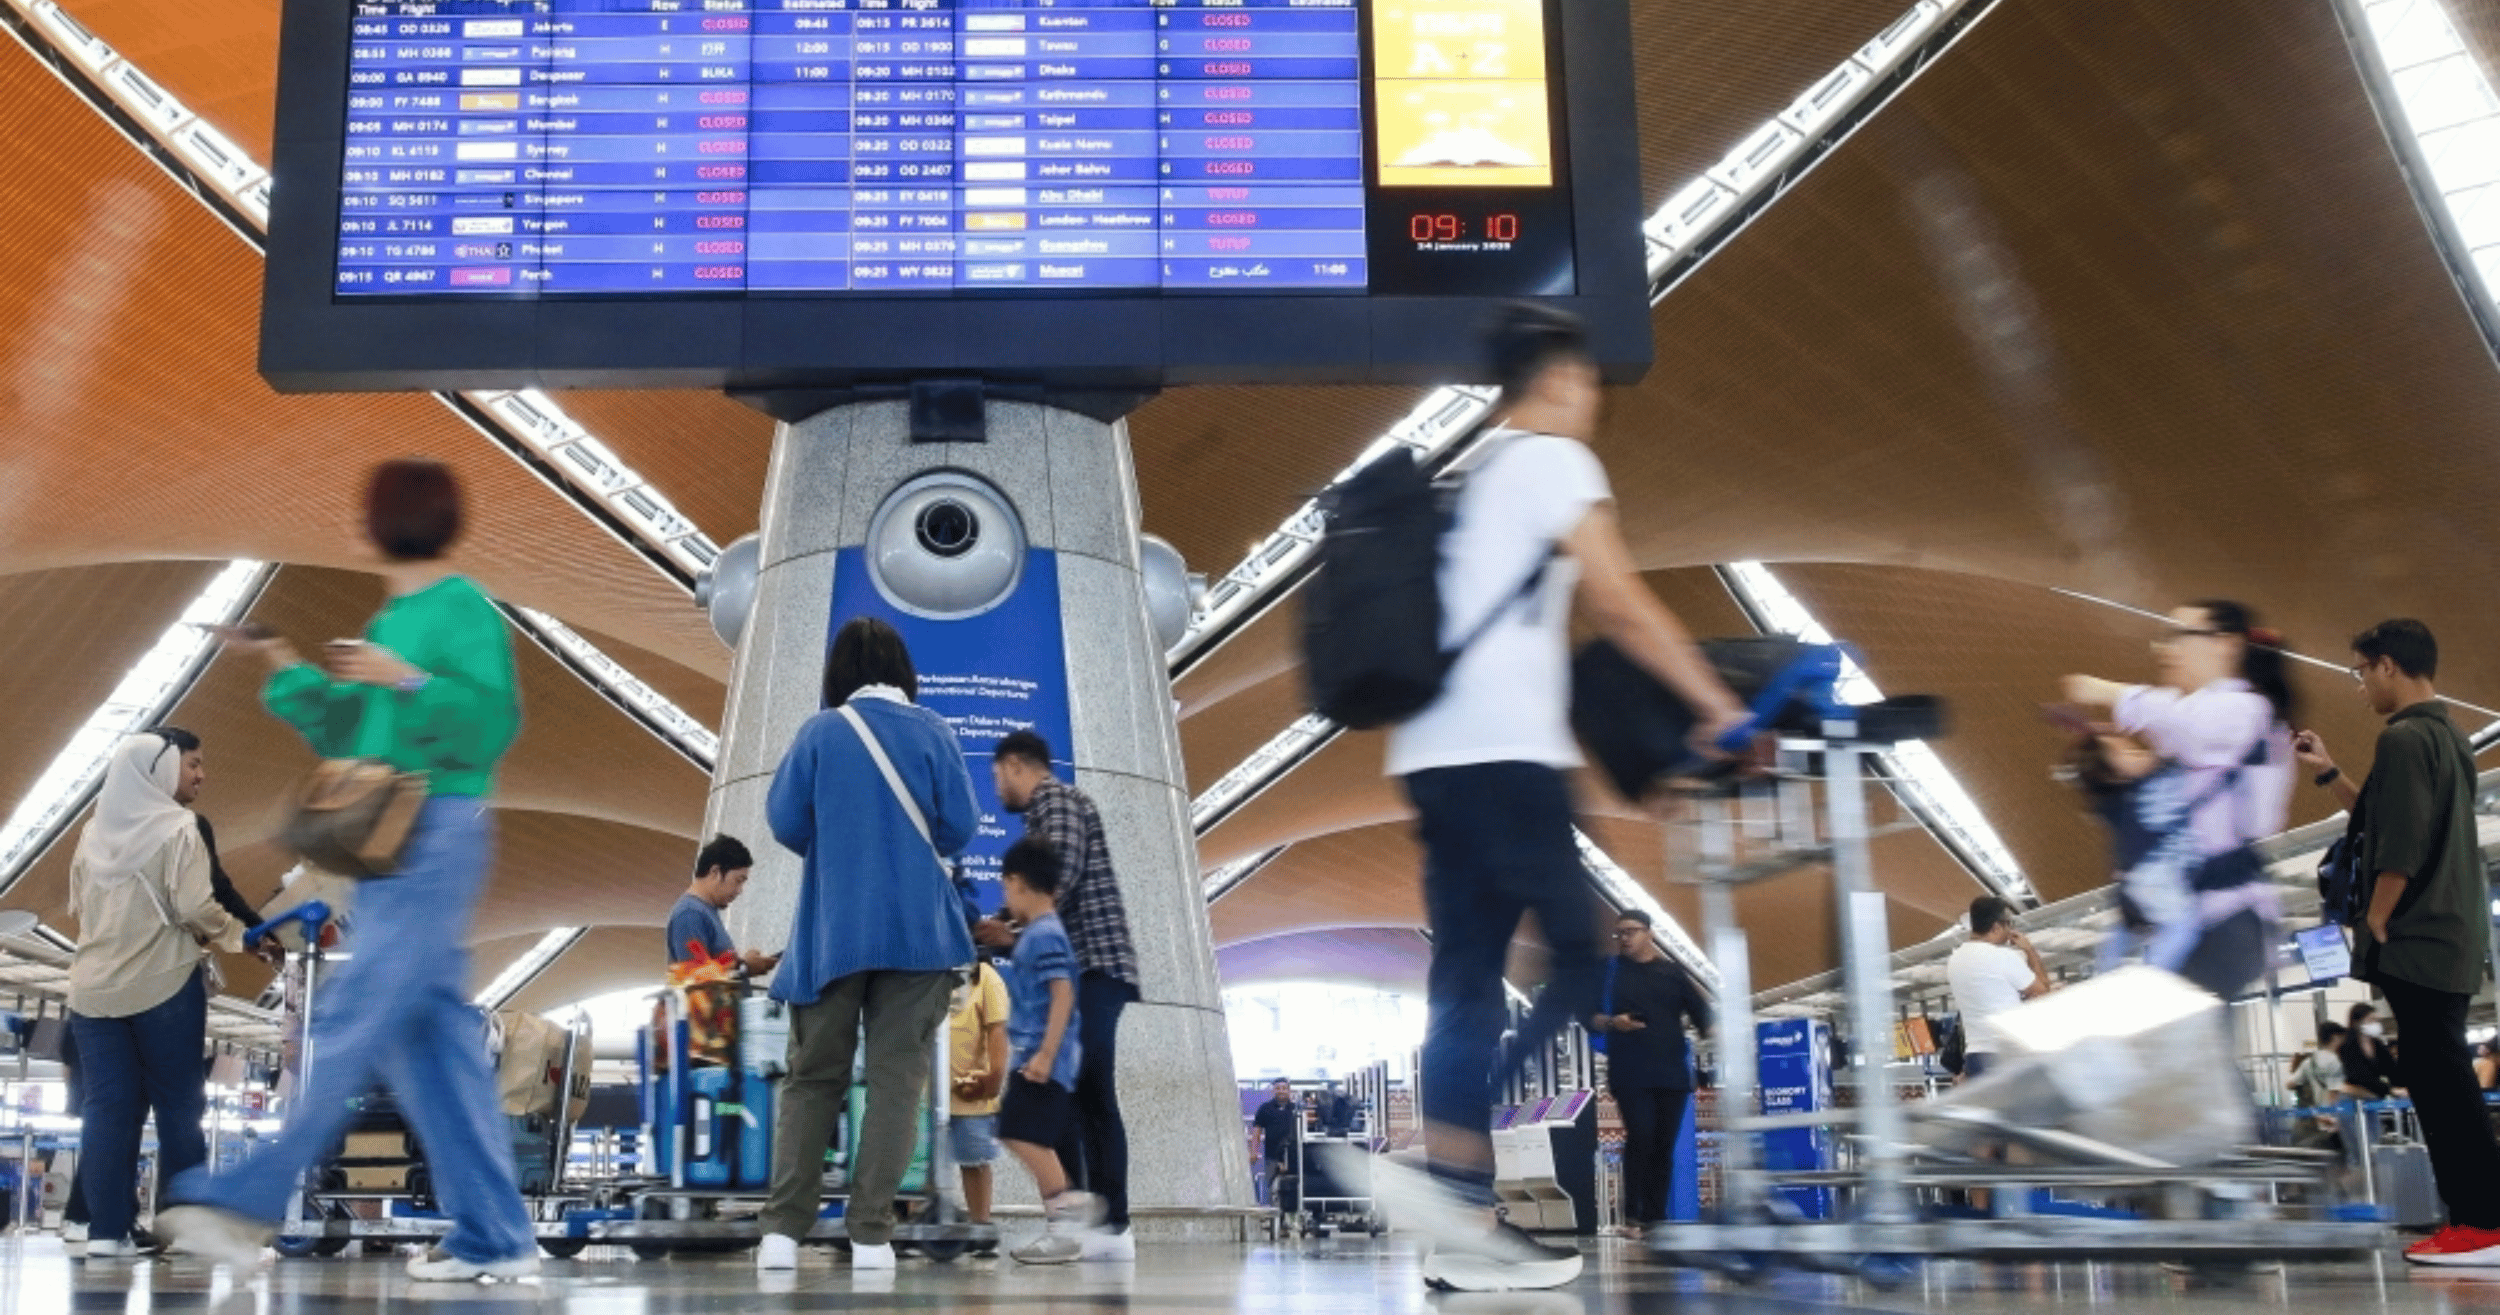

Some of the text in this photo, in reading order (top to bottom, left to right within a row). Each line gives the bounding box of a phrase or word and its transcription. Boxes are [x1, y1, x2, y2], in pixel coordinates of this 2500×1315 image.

[358, 4, 387, 16] Time
[400, 4, 435, 18] Flight
[652, 0, 679, 10] Row
[704, 0, 743, 11] Status
[702, 17, 748, 30] CLOSED
[1203, 14, 1251, 27] CLOSED
[1204, 38, 1251, 51] CLOSED
[701, 67, 734, 78] BUKA
[1204, 62, 1251, 75] CLOSED
[699, 91, 747, 104] CLOSED
[1204, 87, 1253, 101] CLOSED
[699, 116, 745, 128] CLOSED
[1205, 112, 1253, 124] CLOSED
[698, 140, 746, 153] CLOSED
[1205, 136, 1253, 149] CLOSED
[697, 165, 745, 179] CLOSED
[1206, 162, 1253, 174] CLOSED
[697, 192, 745, 204] CLOSED
[1208, 188, 1249, 200] TUTUP
[696, 216, 744, 228] CLOSED
[1208, 213, 1256, 225] CLOSED
[695, 241, 743, 254] CLOSED
[1209, 238, 1251, 250] TUTUP
[695, 266, 743, 278] CLOSED
[961, 856, 986, 867] ebih
